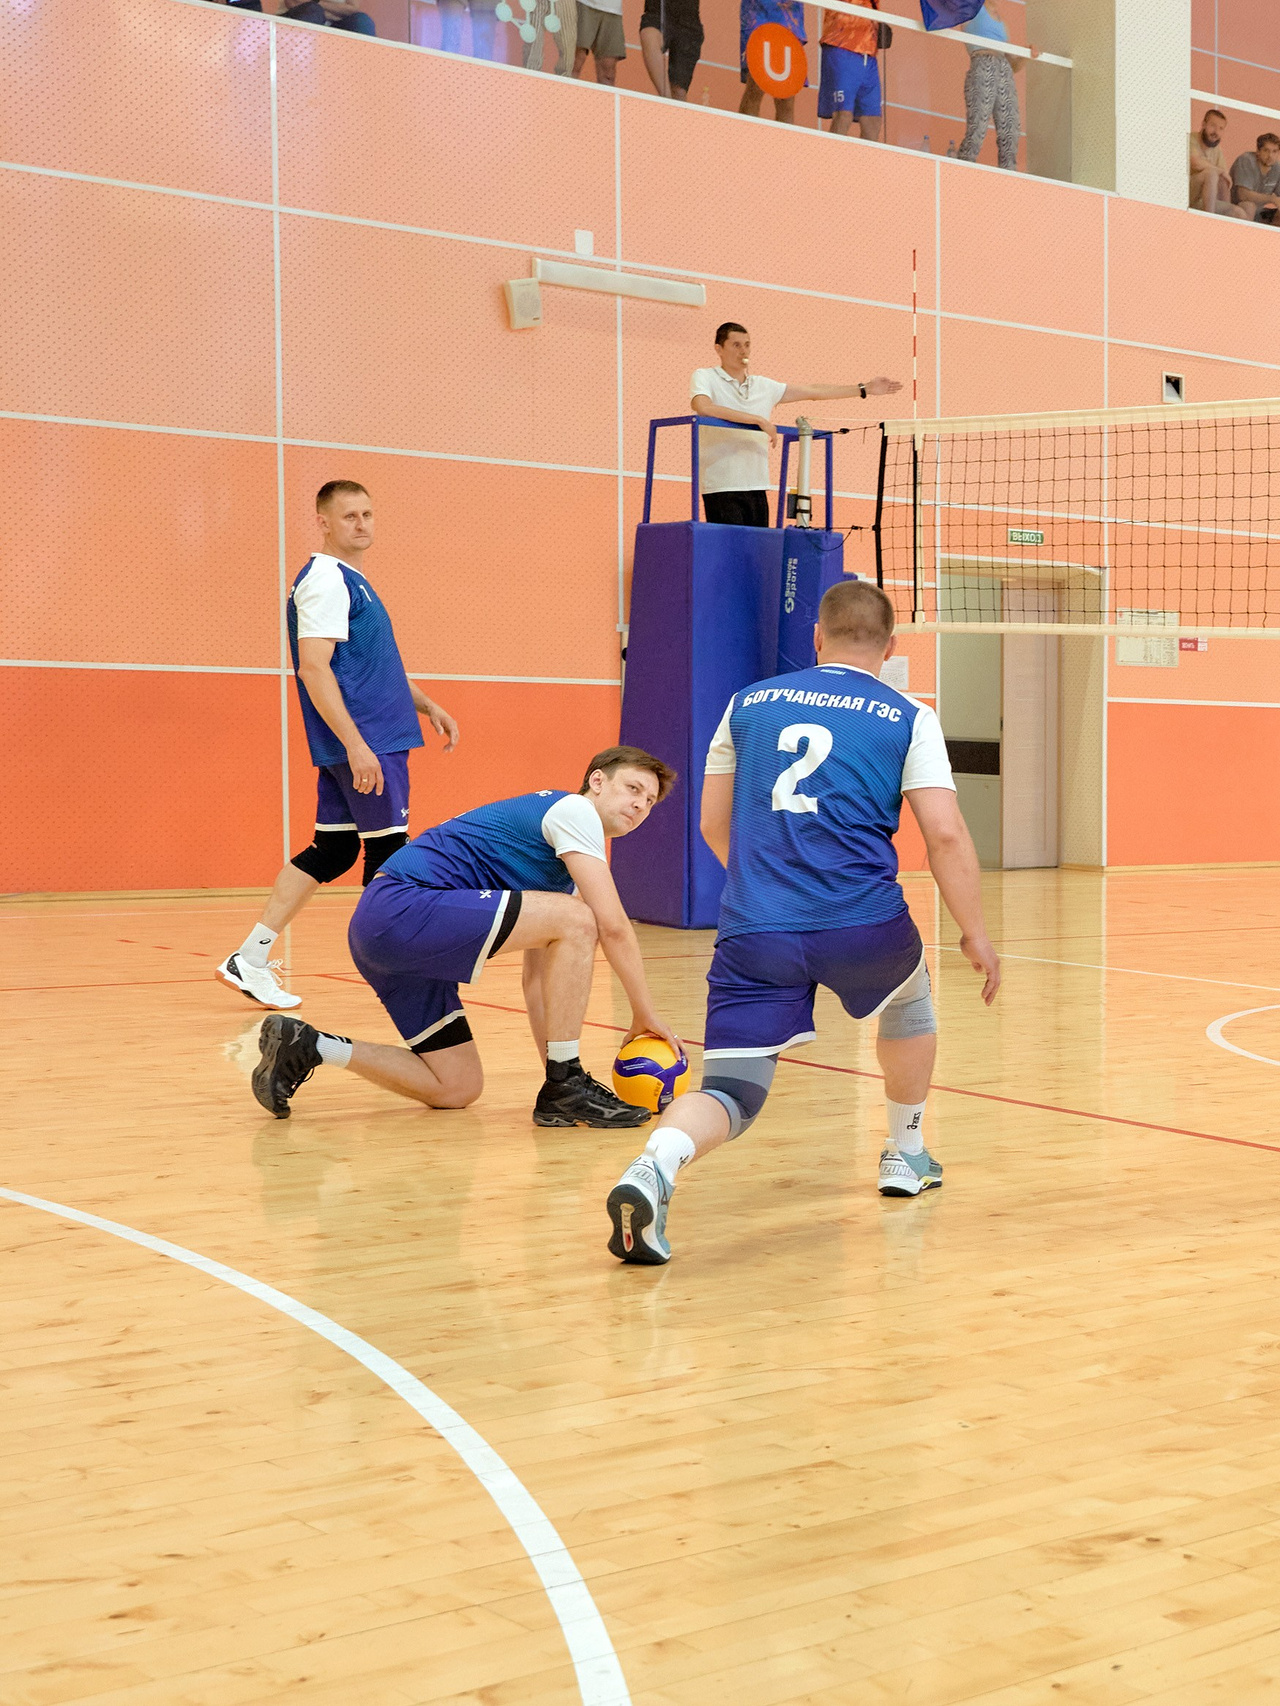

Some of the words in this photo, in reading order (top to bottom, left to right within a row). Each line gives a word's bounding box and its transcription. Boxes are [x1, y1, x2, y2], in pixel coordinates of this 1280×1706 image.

[763, 41, 791, 81] U
[833, 90, 845, 103] 15
[742, 688, 866, 711] БОГУЧАНСКАЯ
[866, 700, 903, 722] ГЭС
[771, 723, 833, 814] 2
